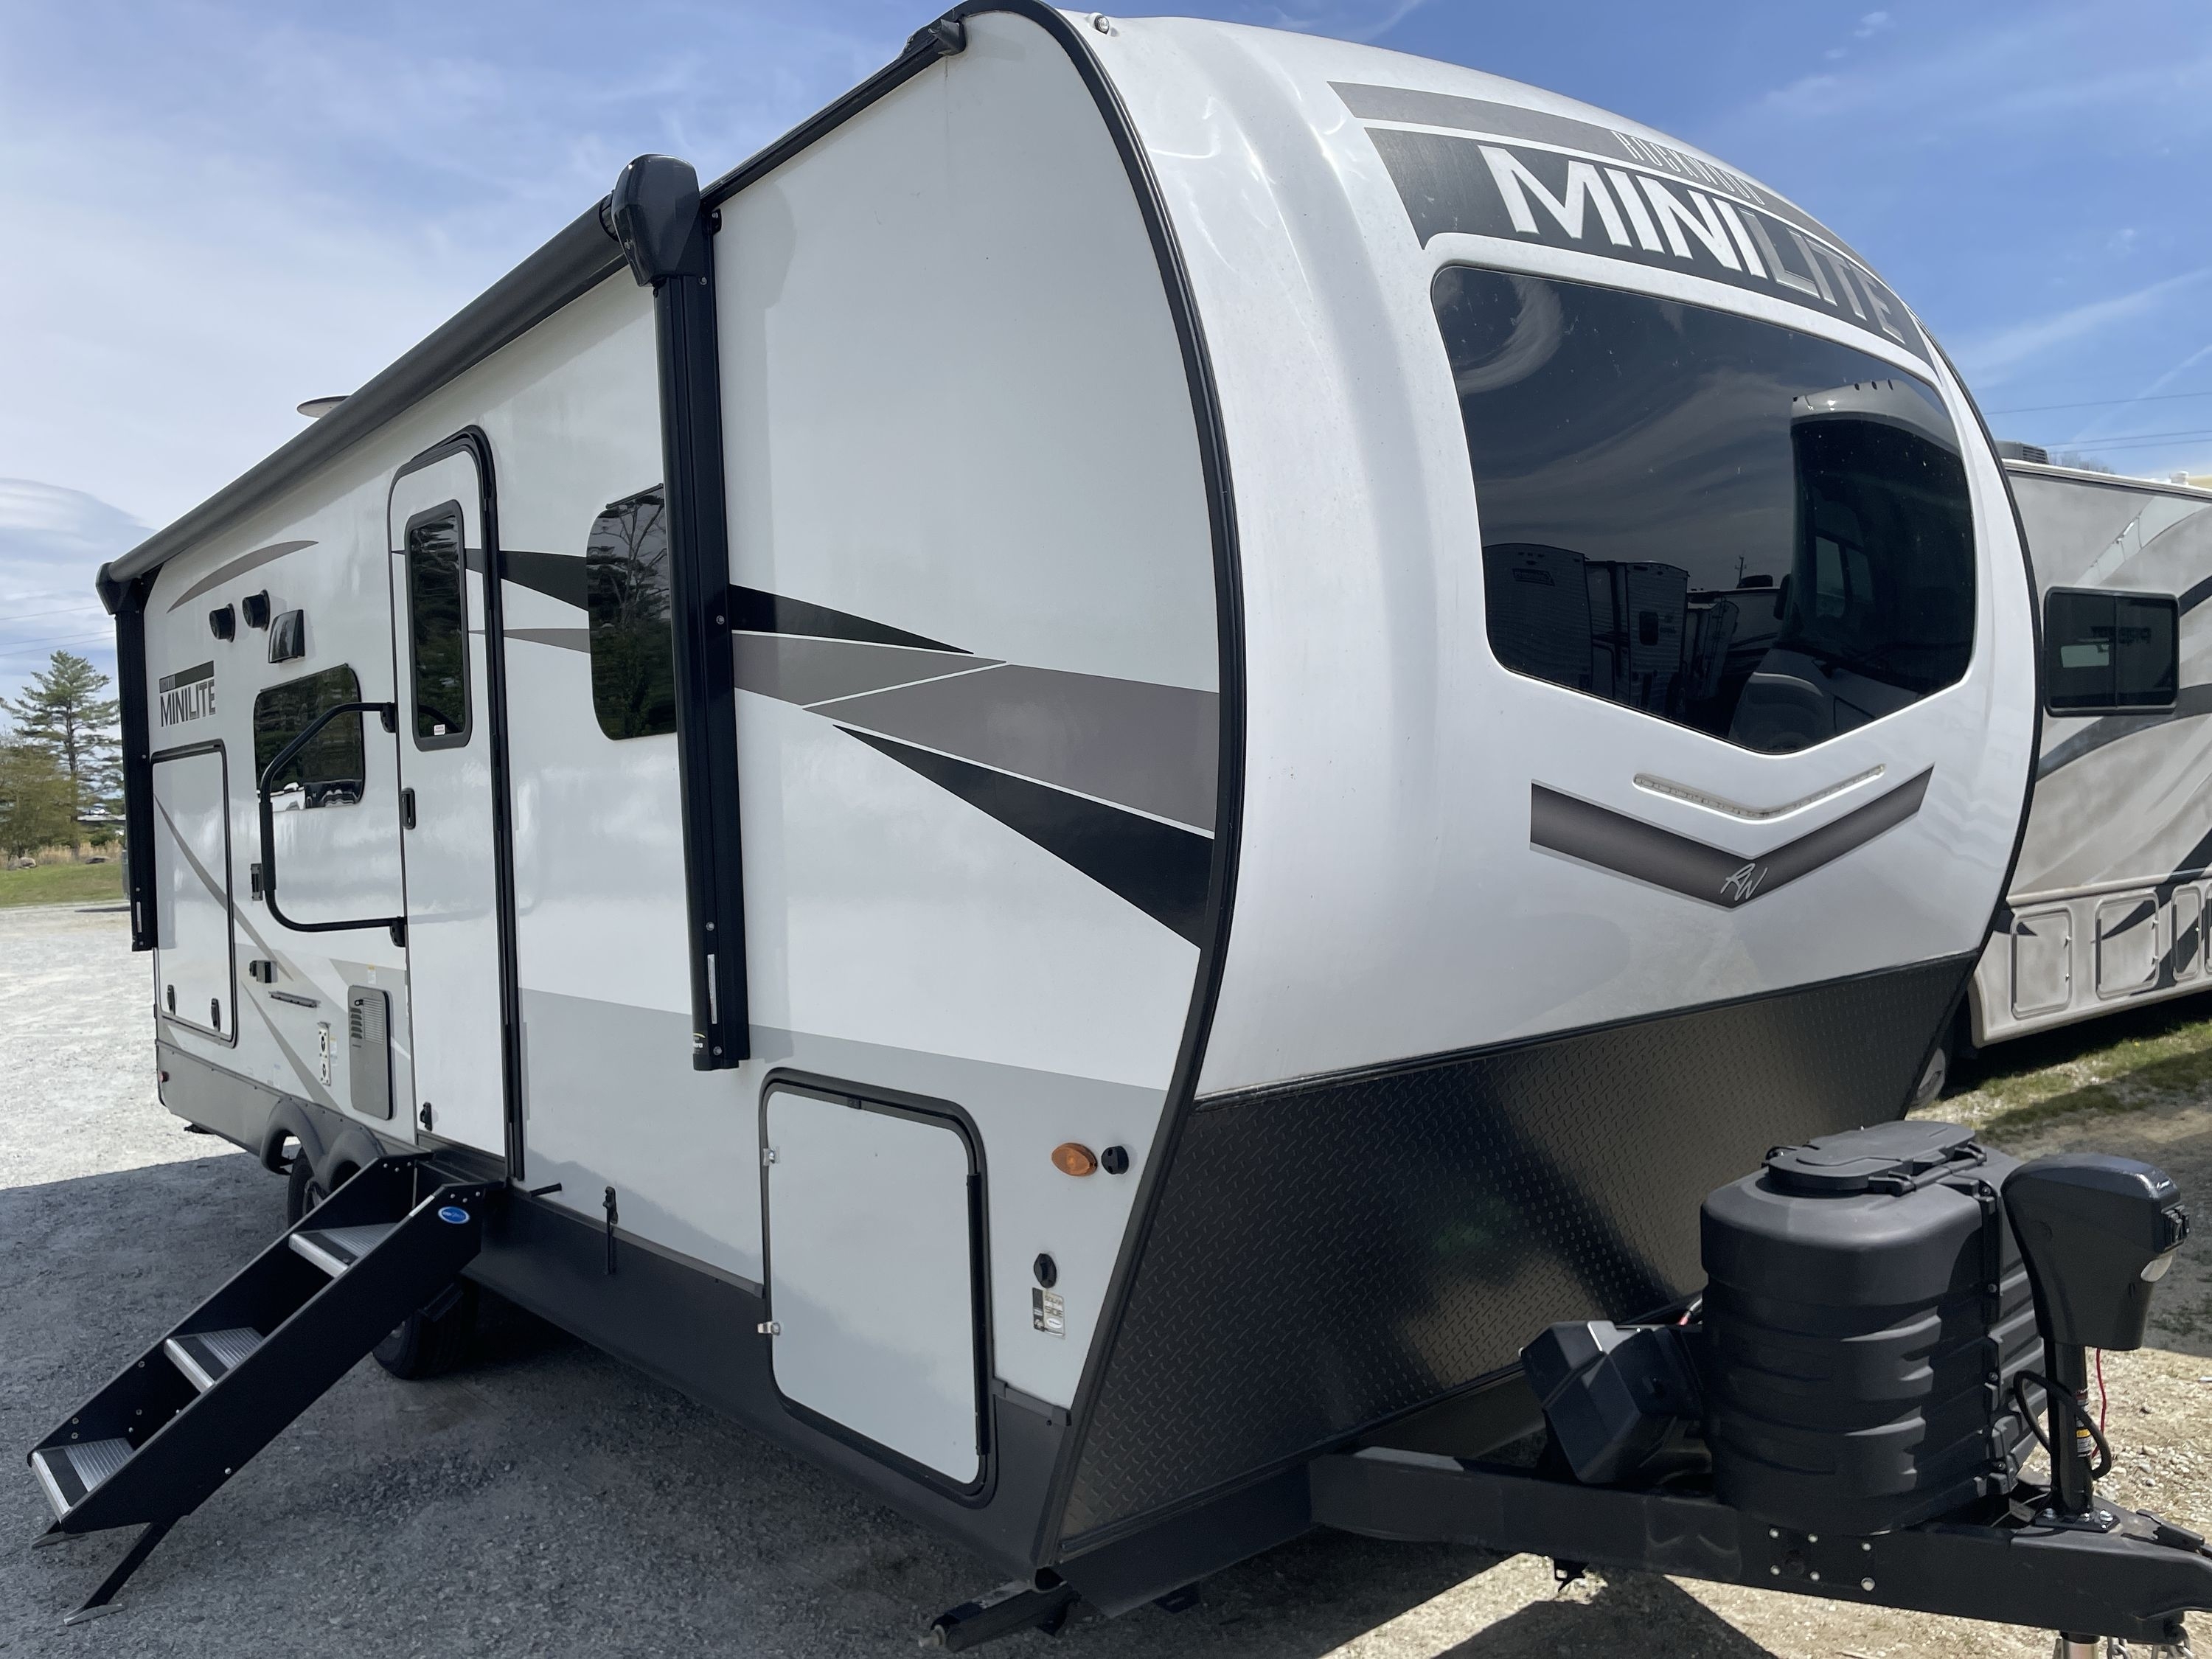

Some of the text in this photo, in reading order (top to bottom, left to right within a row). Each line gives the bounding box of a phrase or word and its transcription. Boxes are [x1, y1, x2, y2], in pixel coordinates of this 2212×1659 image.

[1477, 145, 1906, 345] MINILITE
[160, 678, 216, 727] MINILITE
[1044, 1305, 1063, 1318] SIDE
